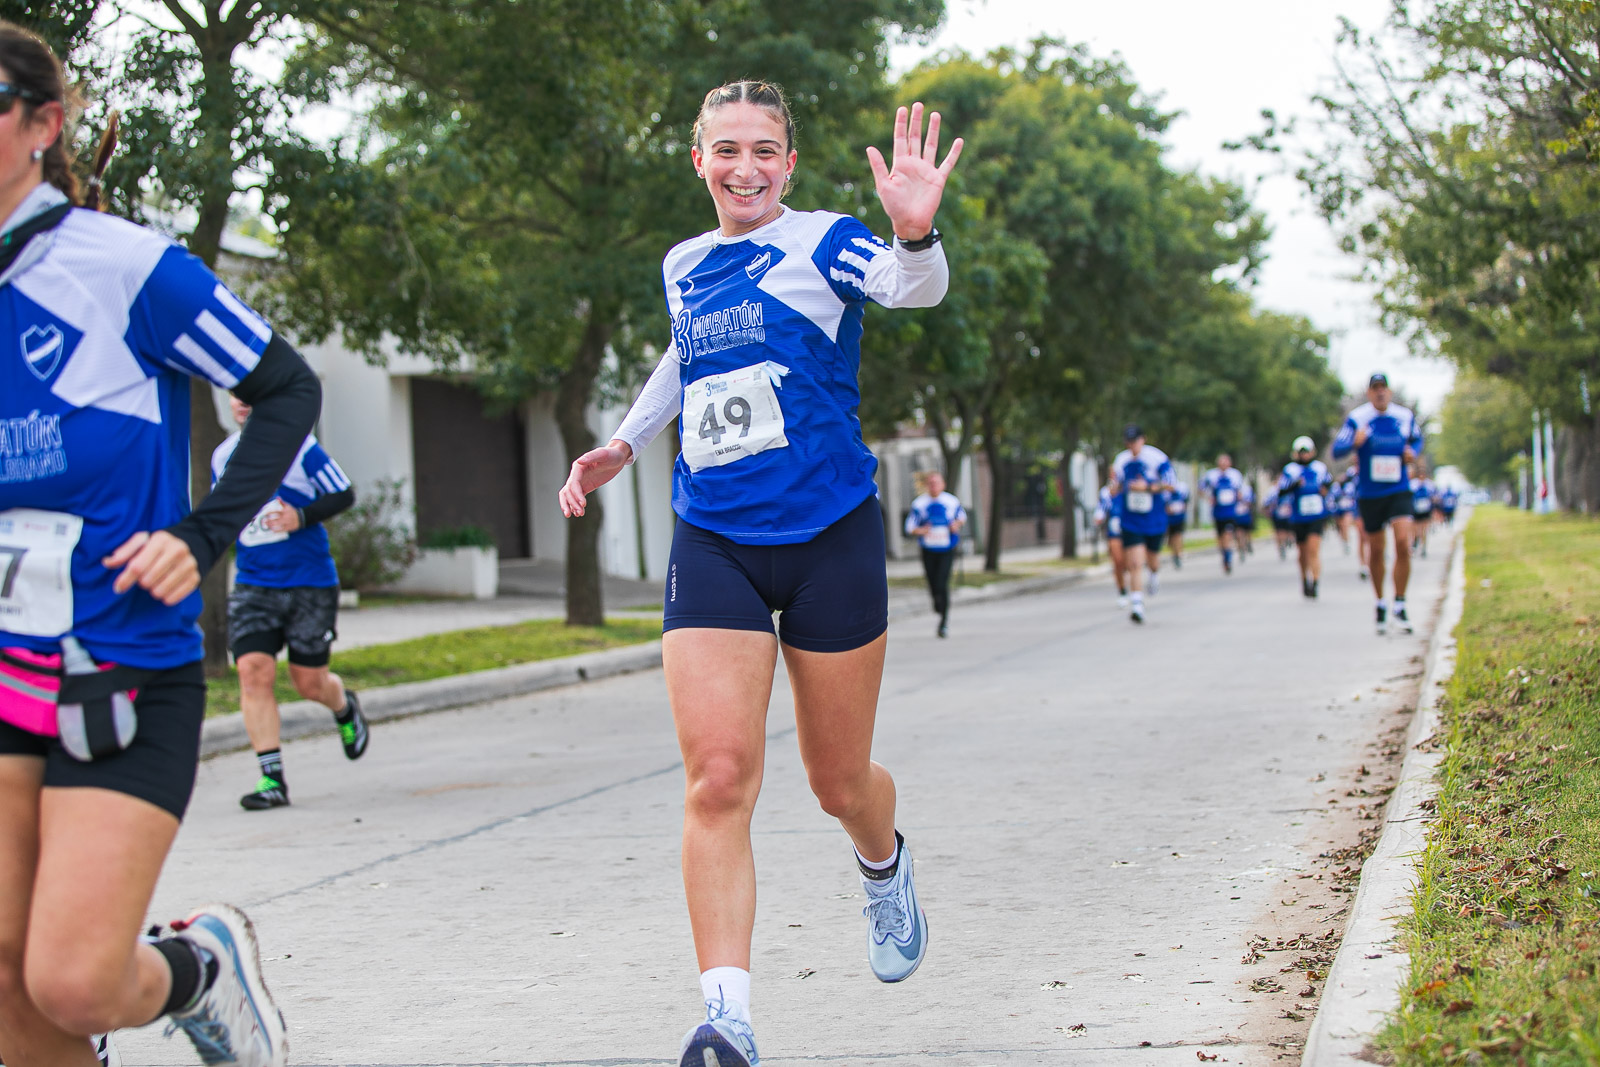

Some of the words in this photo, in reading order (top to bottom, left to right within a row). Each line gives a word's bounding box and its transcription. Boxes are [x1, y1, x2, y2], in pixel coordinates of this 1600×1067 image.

[673, 308, 692, 365] 3
[692, 300, 764, 340] MARATÓN
[698, 396, 752, 445] 49
